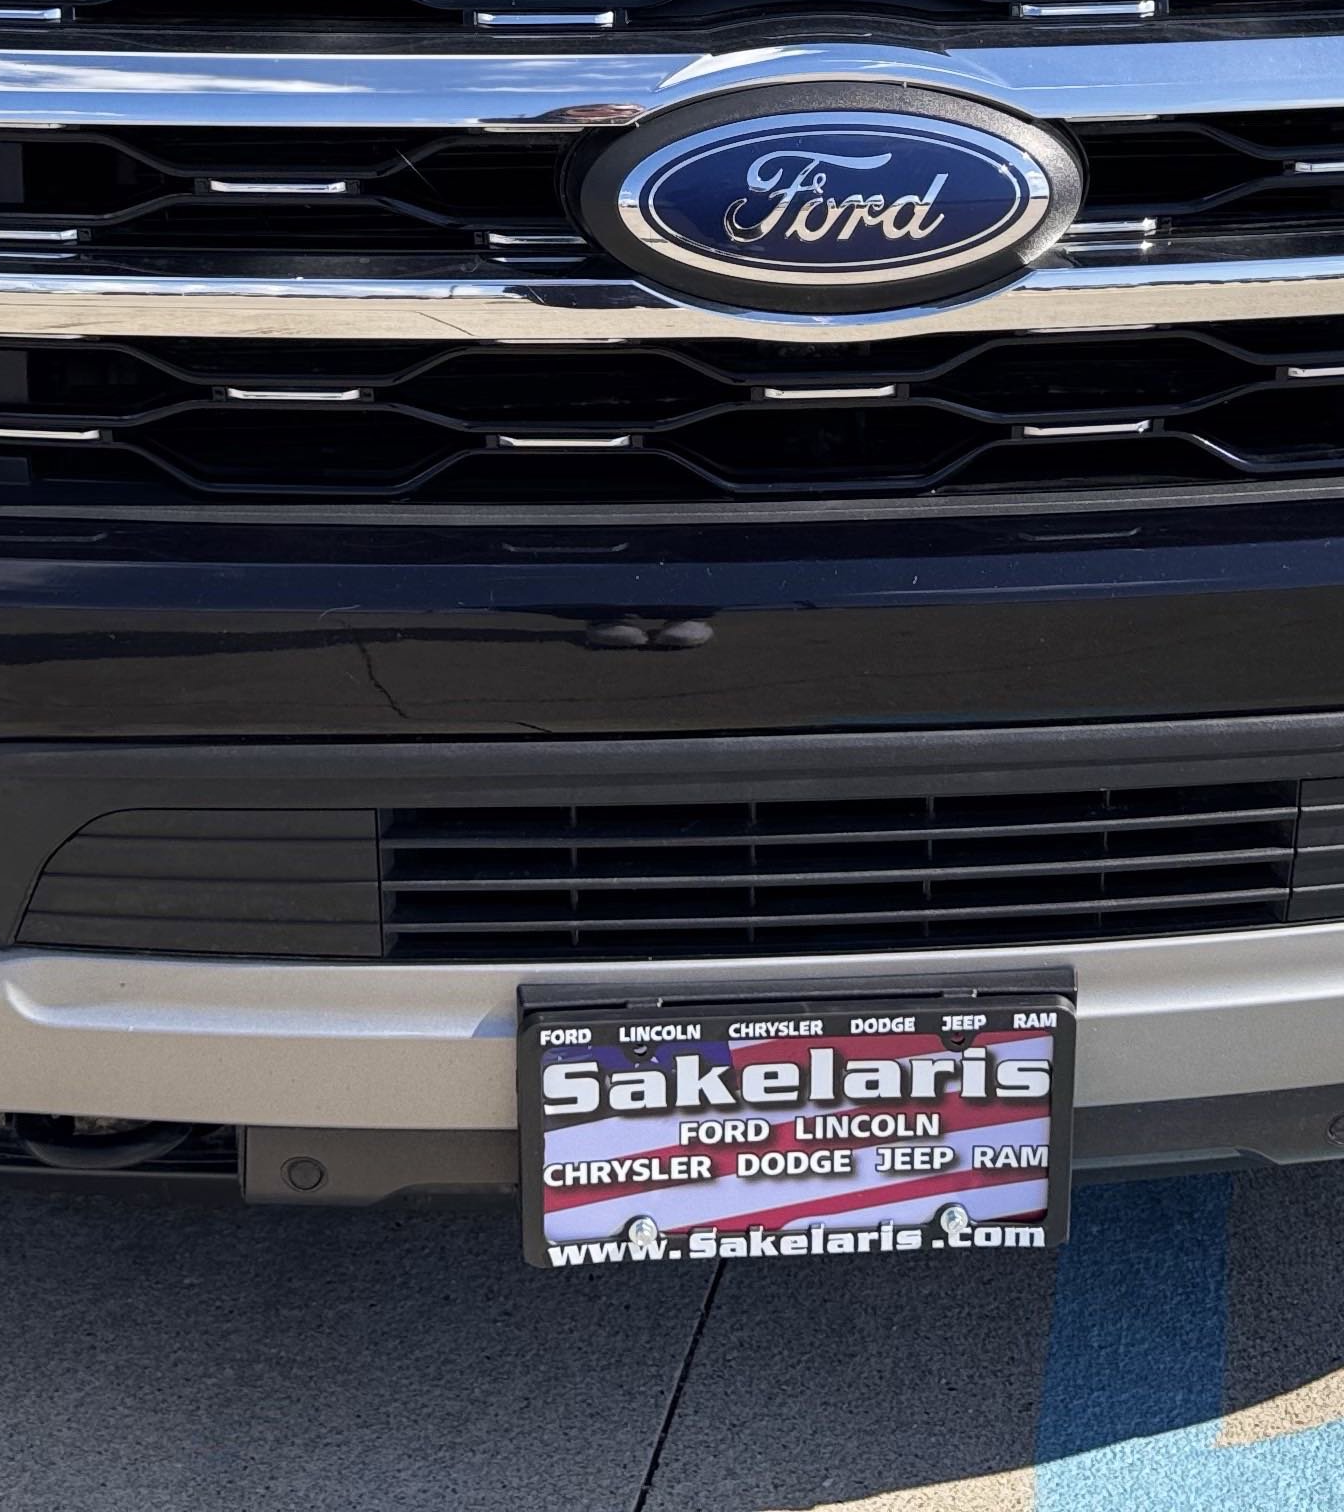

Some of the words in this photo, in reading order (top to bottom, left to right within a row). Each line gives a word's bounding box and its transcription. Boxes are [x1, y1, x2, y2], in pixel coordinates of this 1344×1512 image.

[723, 150, 949, 243] Ford
[540, 1028, 592, 1046] FORD
[618, 1023, 701, 1043] LINCOLN
[728, 1018, 824, 1039] CHRYSLER
[849, 1016, 916, 1034] DODGE
[941, 1014, 988, 1032] JEEP
[1012, 1011, 1057, 1030] RAM
[542, 1046, 1052, 1116] Sakelaris
[679, 1118, 770, 1146] FORD
[794, 1113, 940, 1141] LINCOLN
[542, 1155, 712, 1188] CHRYSLER
[736, 1147, 852, 1177] DODGE
[874, 1145, 954, 1172] JEEP
[972, 1144, 1049, 1169] RAM
